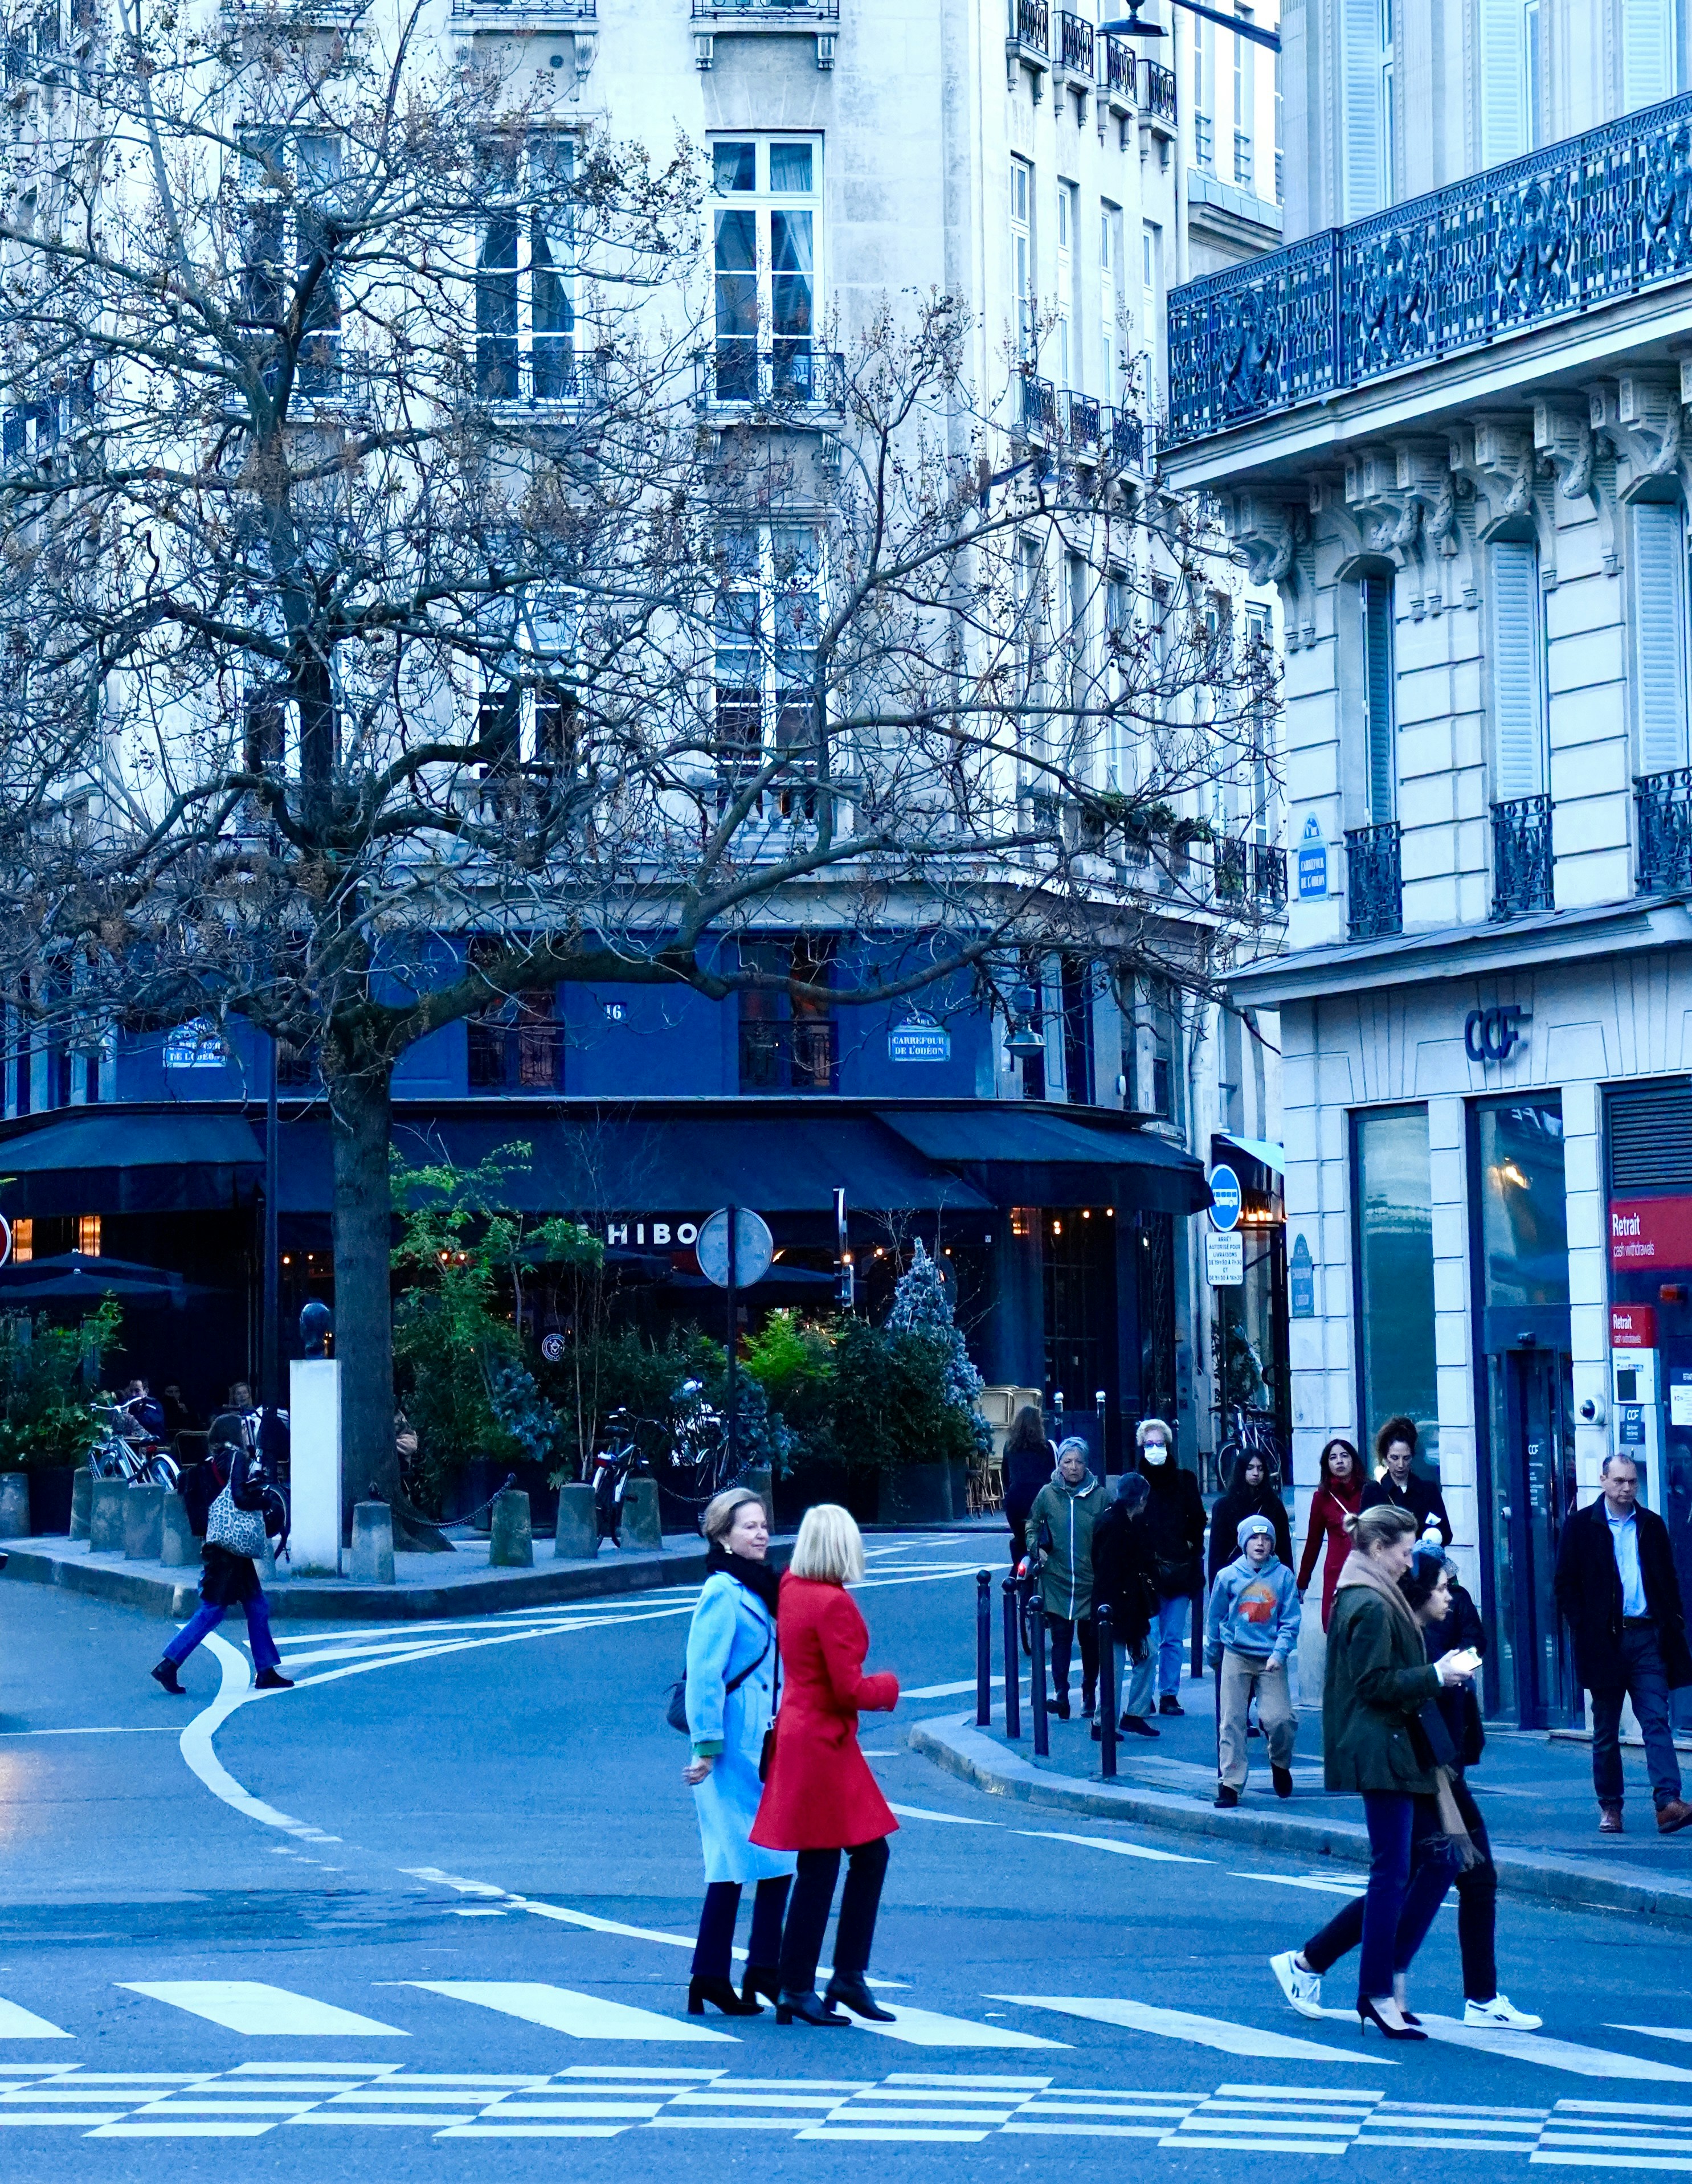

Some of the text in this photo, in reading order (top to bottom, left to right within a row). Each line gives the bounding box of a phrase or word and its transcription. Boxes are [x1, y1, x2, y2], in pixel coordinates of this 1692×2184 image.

[606, 1004, 622, 1019] 16
[893, 1036, 944, 1045] CARREFOUR
[1465, 1005, 1521, 1062] CCF
[909, 1045, 943, 1055] L'ODÉON
[1612, 1212, 1641, 1237] Retrait
[608, 1223, 698, 1245] HIBO
[1613, 1314, 1633, 1330] Retrait
[1627, 1409, 1640, 1421] CCF
